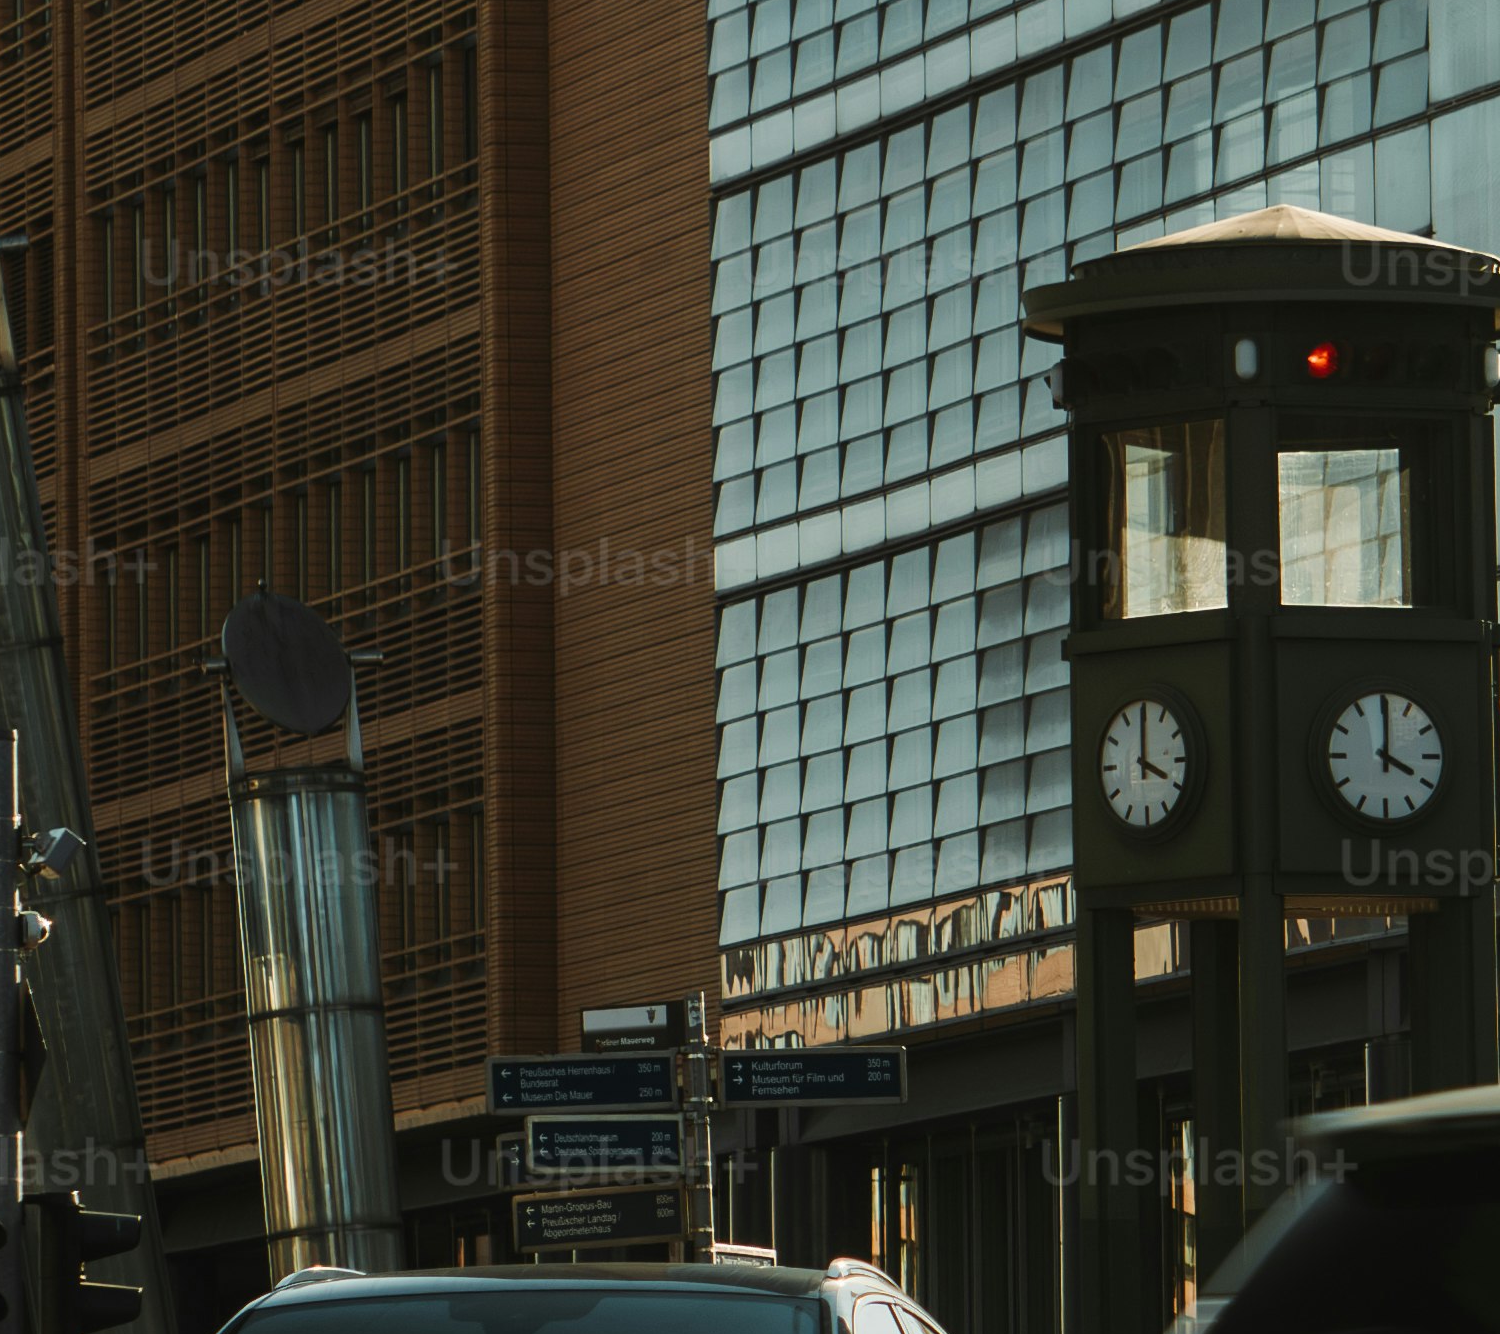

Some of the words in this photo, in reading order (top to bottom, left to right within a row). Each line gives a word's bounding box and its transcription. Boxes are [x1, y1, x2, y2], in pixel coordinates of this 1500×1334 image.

[620, 1036, 655, 1046] Mauerweg
[519, 1067, 566, 1078] Preußisches
[567, 1065, 611, 1076] Herrenhaus
[637, 1063, 652, 1073] 350
[653, 1064, 661, 1072] m
[751, 1061, 803, 1071] Kulturforum
[867, 1058, 881, 1068] 350
[520, 1078, 559, 1089] Bundesrat
[752, 1074, 791, 1084] Museum
[791, 1073, 804, 1083] für
[806, 1073, 826, 1083] Film
[828, 1072, 845, 1082] und
[867, 1071, 882, 1082] 200
[521, 1091, 553, 1102] Museum
[554, 1090, 568, 1100] Die
[569, 1089, 594, 1100] Mauer
[638, 1087, 654, 1098] 250
[752, 1085, 800, 1095] Fernsehen
[554, 1132, 618, 1143] Deutschlandmuseum
[651, 1132, 664, 1142] 200
[651, 1145, 664, 1155] 200
[541, 1200, 613, 1214] Martin-Gropius-Bau
[541, 1216, 586, 1228] Preußischer
[587, 1213, 617, 1225] Landtag
[542, 1226, 612, 1240] Abgeordnetenhaus
